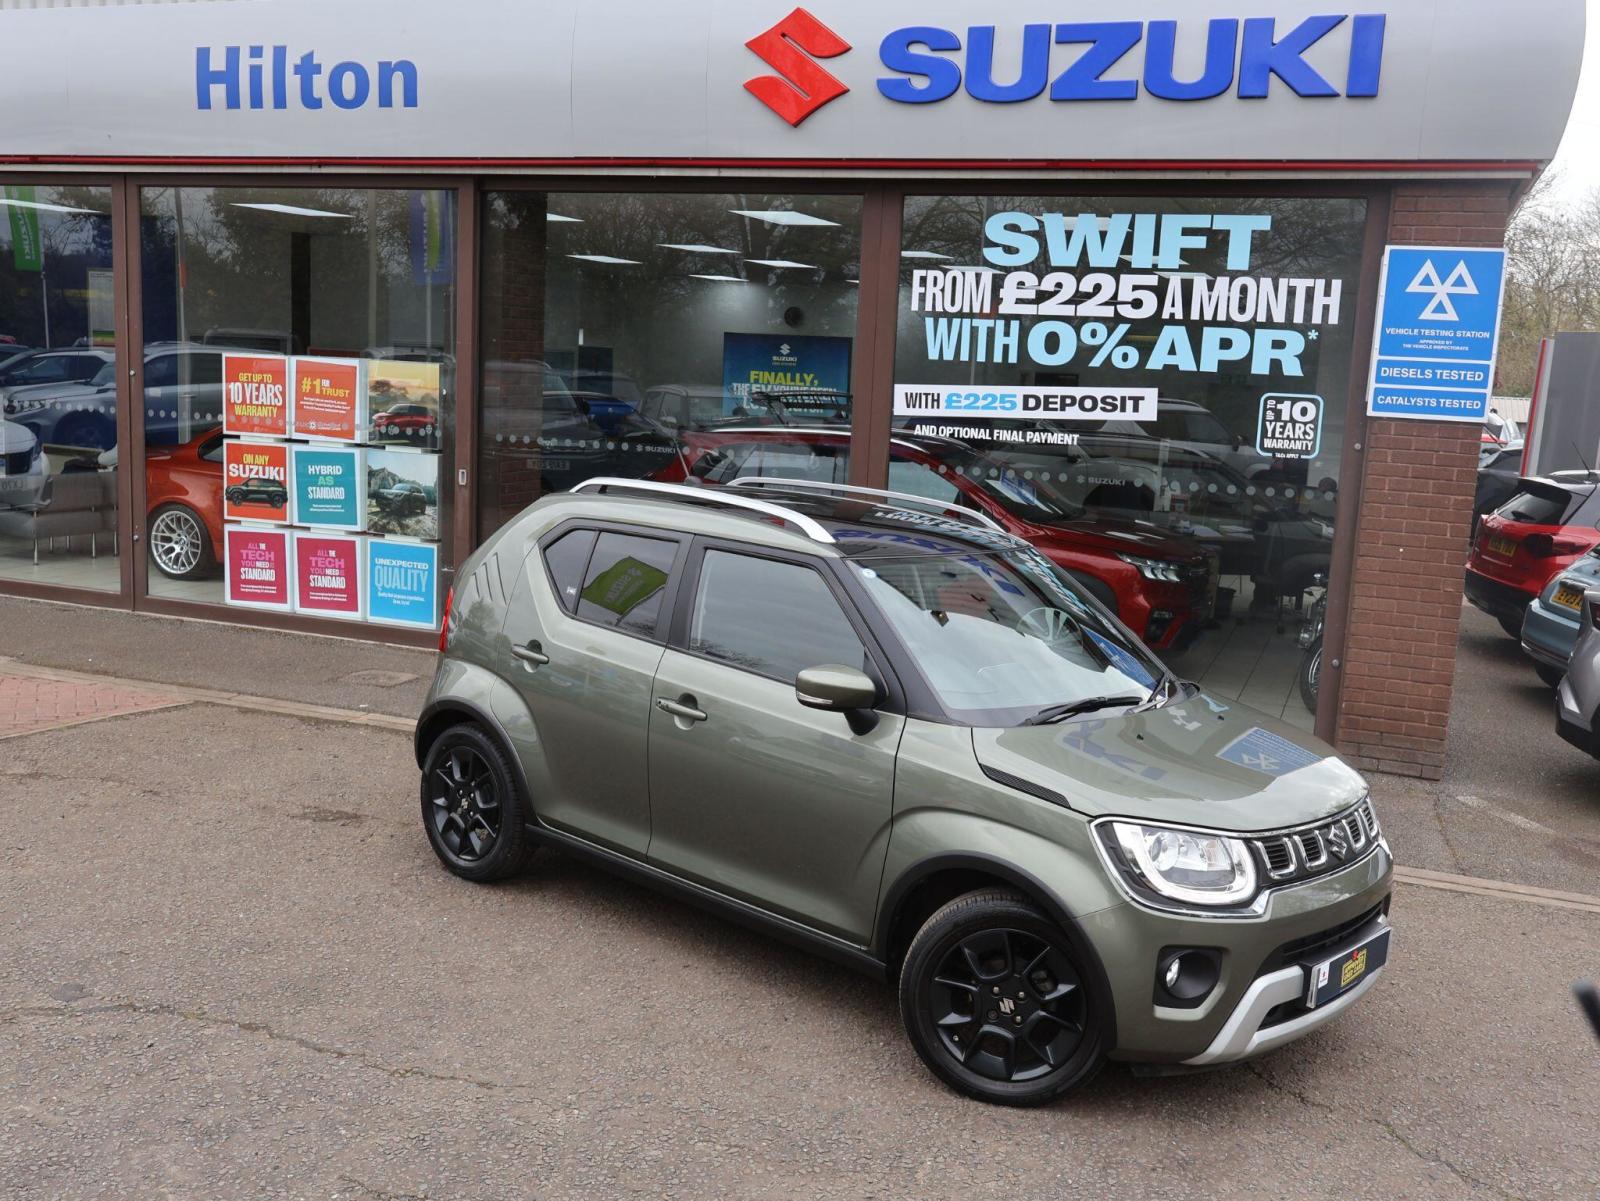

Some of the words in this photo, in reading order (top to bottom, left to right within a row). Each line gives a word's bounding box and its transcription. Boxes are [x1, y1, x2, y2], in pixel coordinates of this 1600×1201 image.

[877, 14, 1386, 103] SUZUKI
[196, 45, 418, 109] Hilton
[983, 211, 1271, 270] SWIFT
[911, 269, 993, 313] FROM
[999, 271, 1158, 319] £225
[1161, 276, 1183, 320] A
[1189, 277, 1342, 325] MONTH
[1385, 327, 1419, 336] VEHICLE
[1420, 328, 1454, 337] TESTING
[1455, 330, 1490, 339] STATION
[925, 317, 1019, 364] WITH
[1027, 320, 1140, 369] 0%
[238, 372, 252, 382] GET
[253, 373, 262, 382] UP
[262, 374, 272, 383] TO
[750, 370, 819, 386] FINALLY,
[1380, 367, 1433, 379] DIESELS
[1435, 370, 1483, 381] TESTED
[301, 376, 321, 395] #1
[322, 387, 351, 398] TRUST
[732, 382, 750, 396] THE
[229, 382, 242, 404] 10
[243, 383, 283, 406] YEARS
[904, 392, 940, 409] WITH
[944, 392, 1017, 411] £225
[1022, 394, 1145, 413] DEPOSIT
[1267, 399, 1276, 409] TO
[1377, 395, 1437, 406] CATALYSTS
[1438, 399, 1481, 409] TESTED
[234, 404, 277, 417] WARRANTY
[1266, 410, 1275, 420] UP
[1276, 400, 1317, 422] 10
[914, 424, 937, 437] AND
[938, 426, 991, 440] OPTIONAL
[993, 429, 1025, 442] FINAL
[1026, 431, 1079, 445] PAYMENT
[1265, 421, 1315, 440] YEARS
[645, 446, 676, 454] SUZUKI
[1264, 438, 1313, 450] WARRANTY
[243, 454, 254, 464] ON
[255, 454, 269, 465] ANY
[228, 463, 285, 481] SUZUKI
[308, 465, 343, 475] HYBRID
[318, 476, 334, 486] AS
[1088, 476, 1126, 487] SUZUKI
[308, 486, 345, 500] STANDARD
[240, 550, 275, 561] TECH
[309, 557, 345, 568] TECH
[375, 557, 429, 569] UNEXPECTED
[240, 568, 276, 581] STANDARD
[325, 568, 339, 576] NEED
[375, 565, 428, 592] QUALITY
[309, 575, 346, 589] STANDARD
